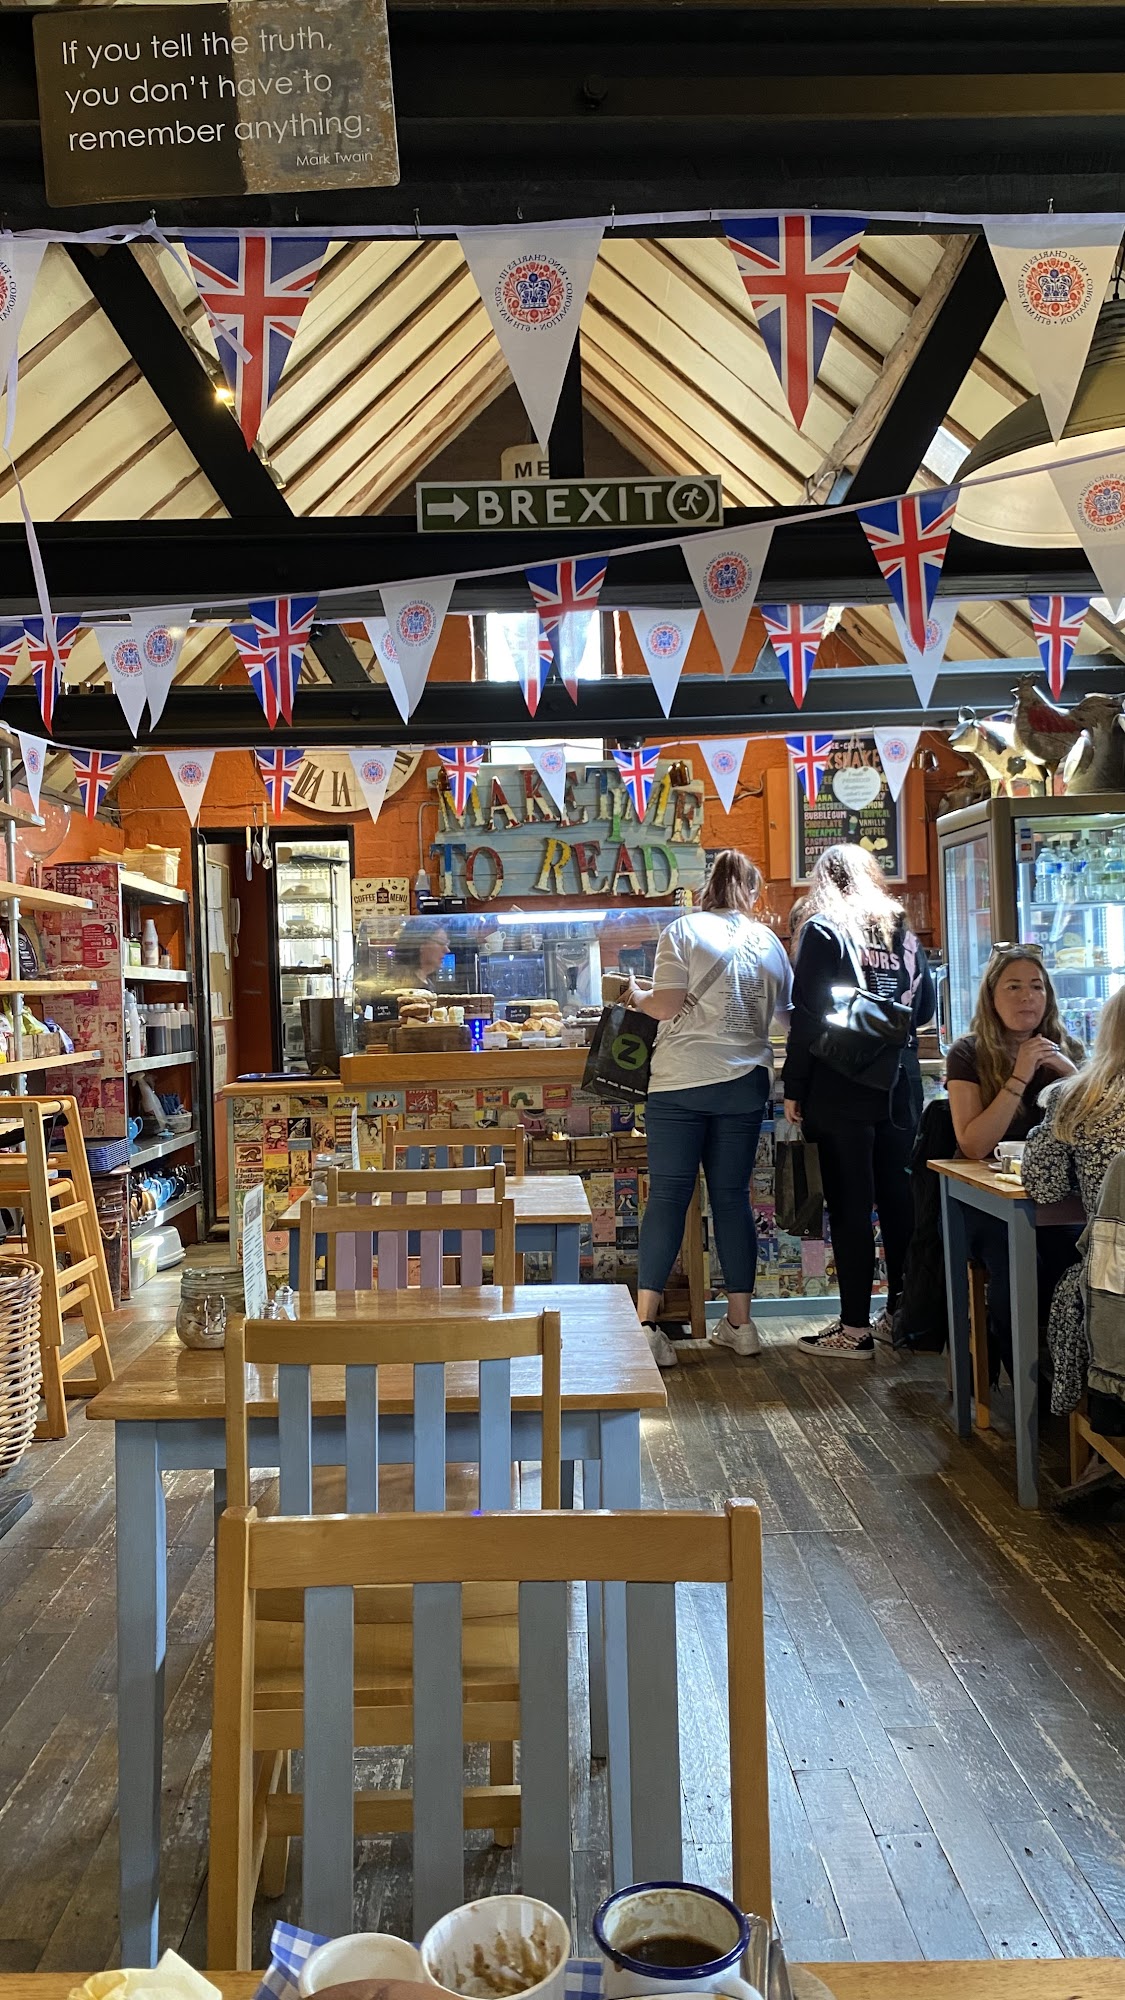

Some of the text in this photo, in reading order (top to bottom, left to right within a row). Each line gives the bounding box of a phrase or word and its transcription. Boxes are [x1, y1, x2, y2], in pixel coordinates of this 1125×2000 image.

[61, 26, 333, 69] If you tell the truth,
[64, 70, 332, 113] you don't have to
[68, 111, 371, 152] remember anything.
[296, 150, 373, 166] Mark Twain
[477, 485, 662, 525] BREXIT
[860, 827, 886, 836] COFFEE
[430, 837, 680, 901] TO READ
[354, 893, 408, 904] COFFEE MENU
[101, 937, 112, 946] 18
[104, 924, 116, 934] 21
